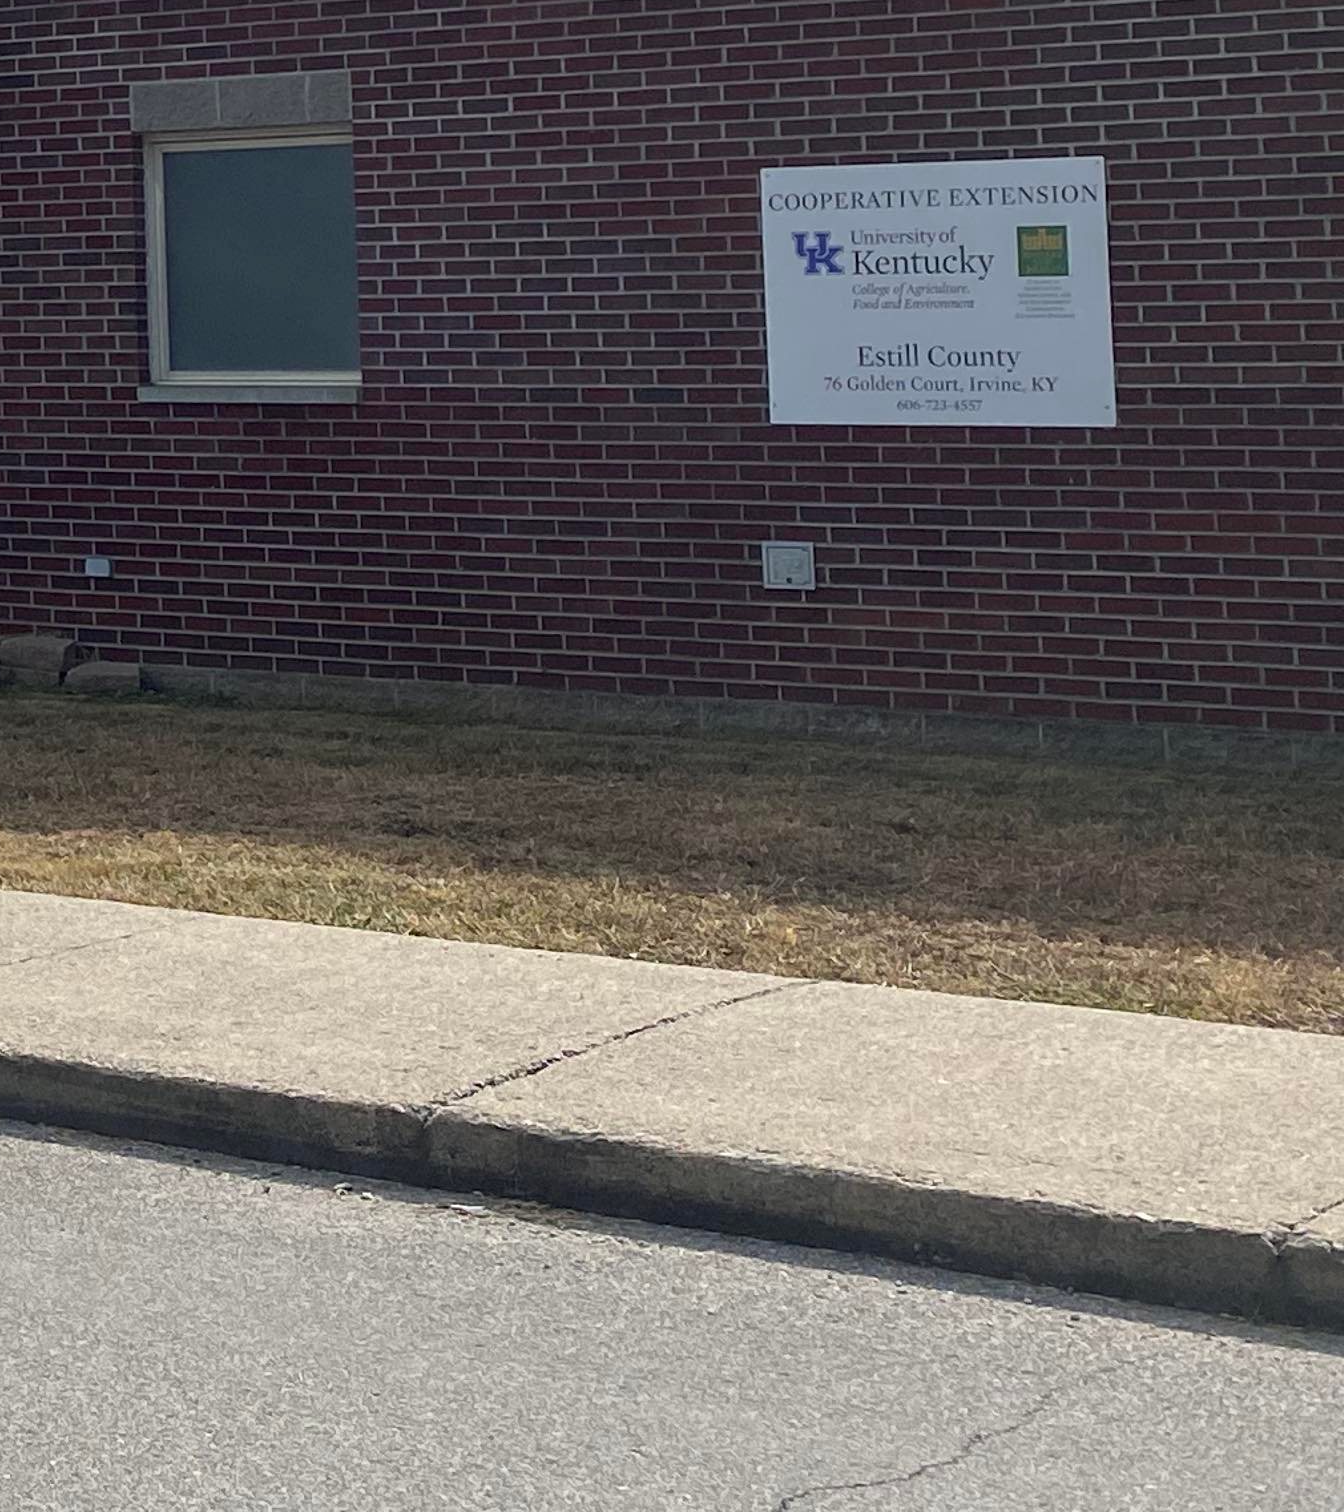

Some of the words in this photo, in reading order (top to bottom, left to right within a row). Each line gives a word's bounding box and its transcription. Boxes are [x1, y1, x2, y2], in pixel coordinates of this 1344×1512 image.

[768, 190, 941, 212] COOPERATIVE
[949, 184, 1099, 207] EXTENSION
[850, 229, 934, 248] University
[934, 226, 958, 245] of
[791, 231, 845, 275] UK
[852, 245, 995, 281] Kentucky
[851, 283, 891, 297] College
[892, 282, 907, 298] of
[852, 298, 880, 310] Food
[880, 298, 902, 309] and
[903, 298, 975, 310] Environment
[857, 344, 919, 369] Estill
[927, 344, 1023, 373] County
[823, 376, 843, 392] 76
[847, 375, 907, 392] Golden
[1031, 376, 1059, 392] KY
[896, 398, 983, 412] 606-723-4557
